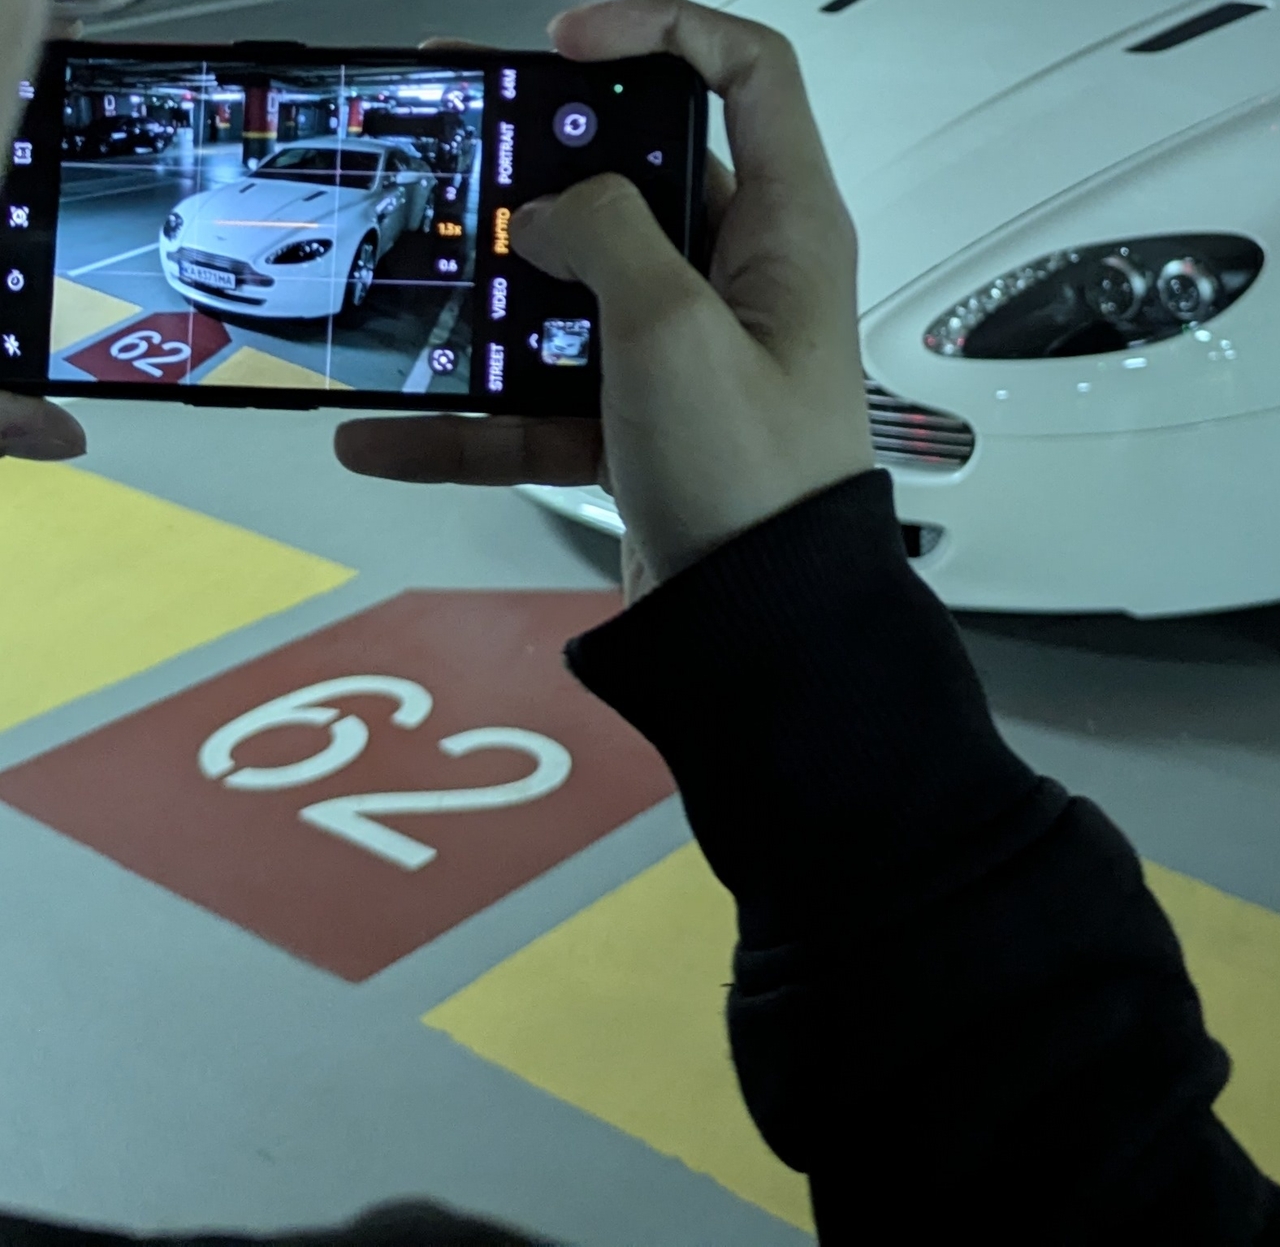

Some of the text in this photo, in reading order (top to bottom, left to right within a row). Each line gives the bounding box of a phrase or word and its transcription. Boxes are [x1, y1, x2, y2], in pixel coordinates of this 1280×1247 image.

[499, 121, 515, 184] PORTRAIT
[494, 207, 511, 254] PHOTO
[491, 277, 507, 320] VIDEO
[110, 330, 192, 378] 62
[488, 342, 504, 392] STREET
[198, 674, 573, 871] 62
